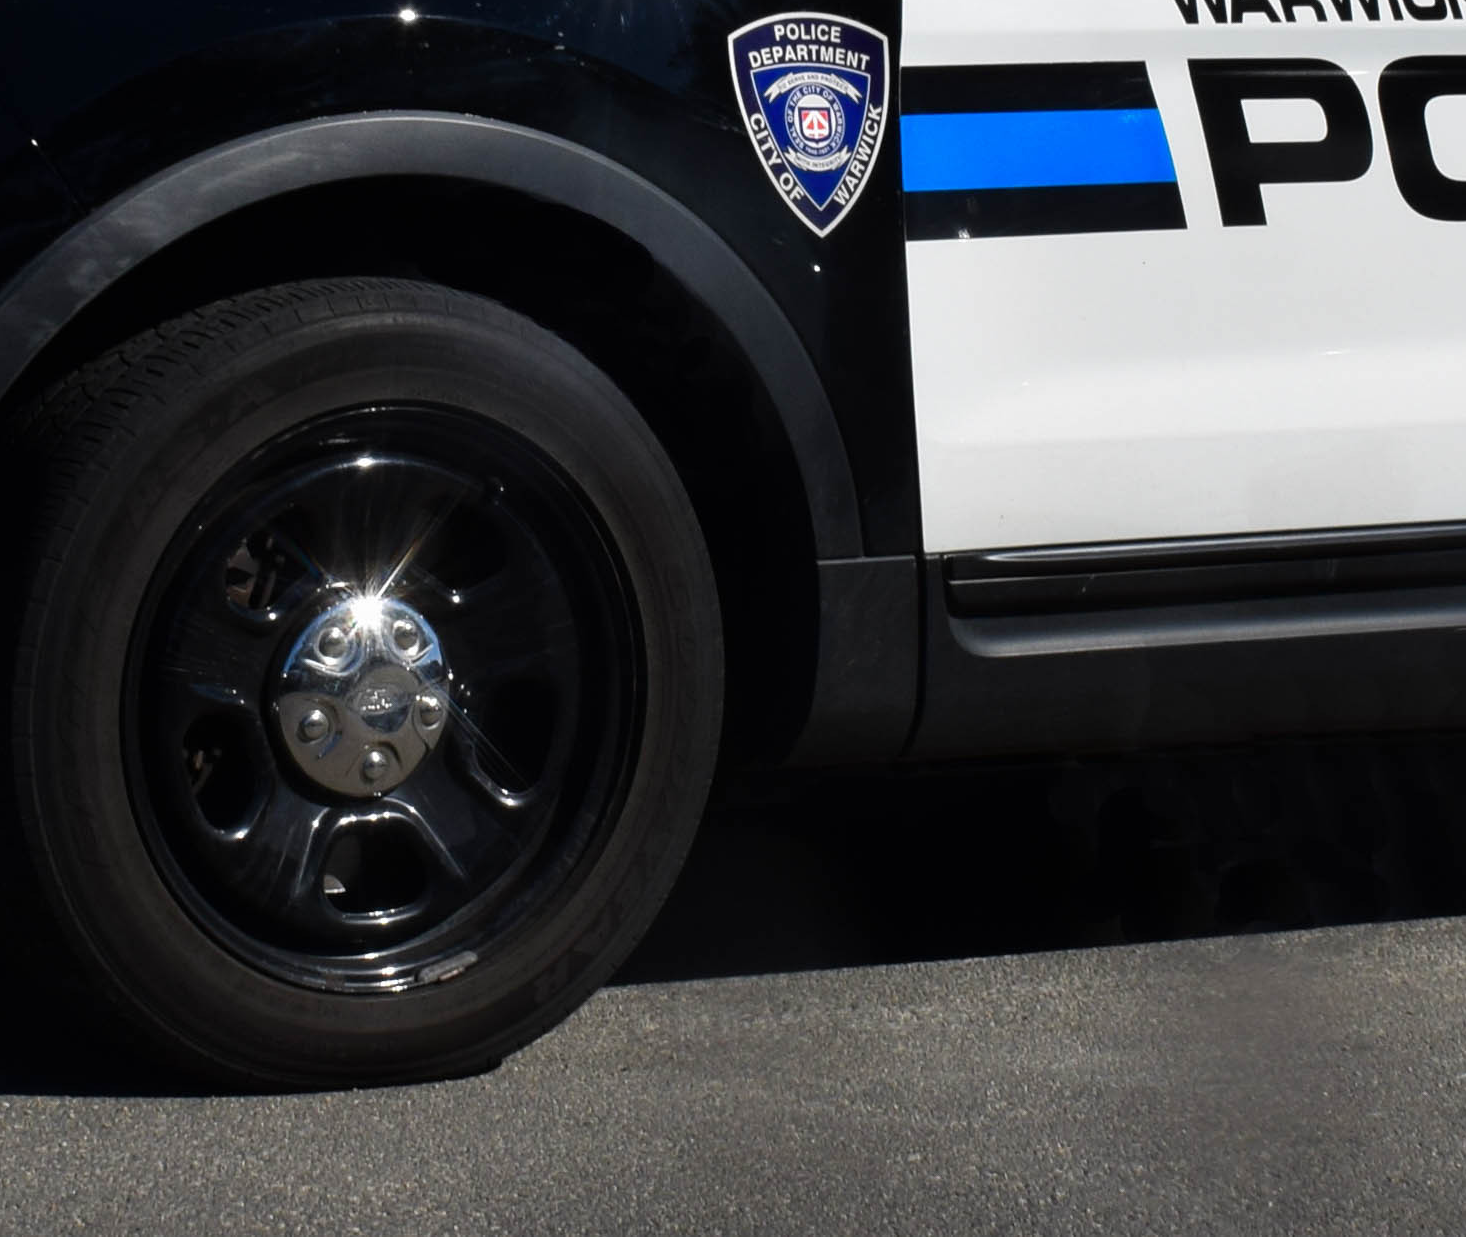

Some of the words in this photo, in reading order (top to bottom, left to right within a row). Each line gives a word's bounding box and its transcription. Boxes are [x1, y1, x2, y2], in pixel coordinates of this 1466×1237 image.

[774, 23, 842, 43] POLICE
[748, 44, 870, 71] DEPARTMENT
[749, 113, 782, 167] CITY
[779, 172, 805, 201] OF
[834, 103, 883, 206] WARWICK
